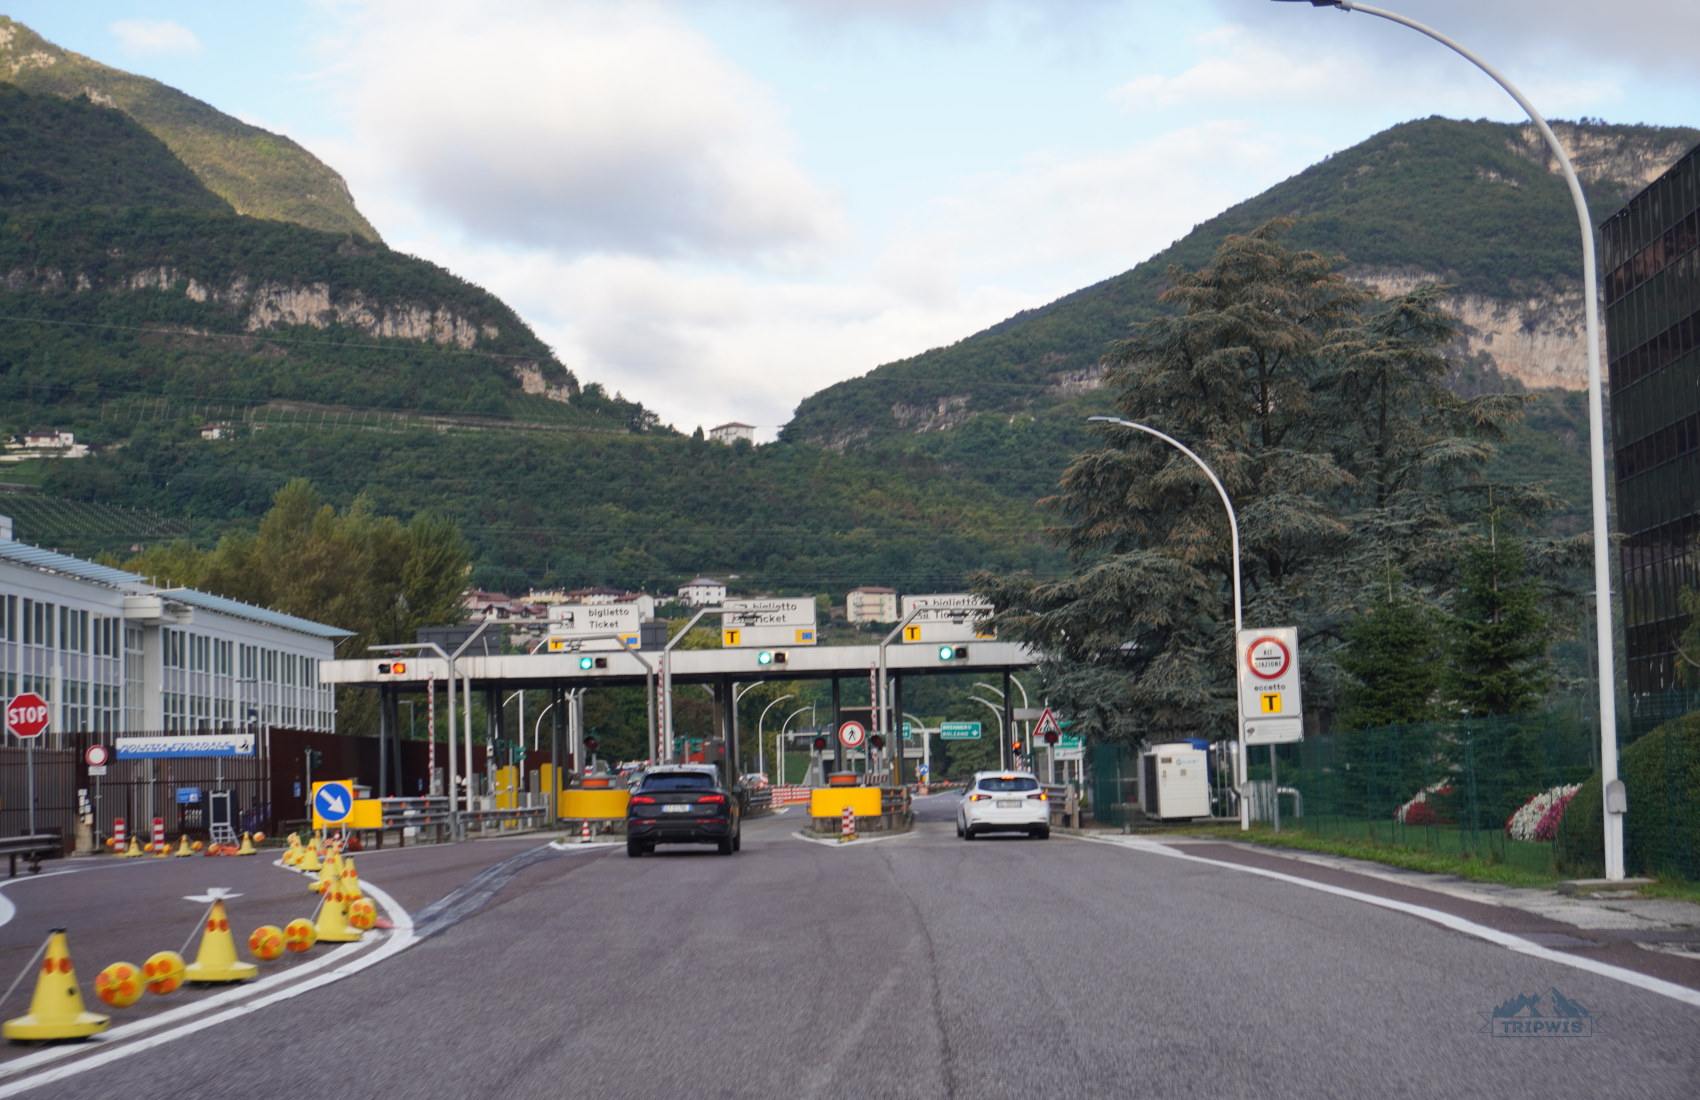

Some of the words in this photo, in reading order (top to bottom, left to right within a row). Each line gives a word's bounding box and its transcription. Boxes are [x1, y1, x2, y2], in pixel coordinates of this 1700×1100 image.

[588, 608, 629, 618] biglietto
[589, 620, 619, 629] Ticket
[726, 631, 738, 644] T
[907, 626, 918, 639] T
[1263, 695, 1278, 711] T
[9, 705, 47, 725] STOP
[120, 743, 168, 753] POLIZIA
[171, 741, 231, 752] STRADALE
